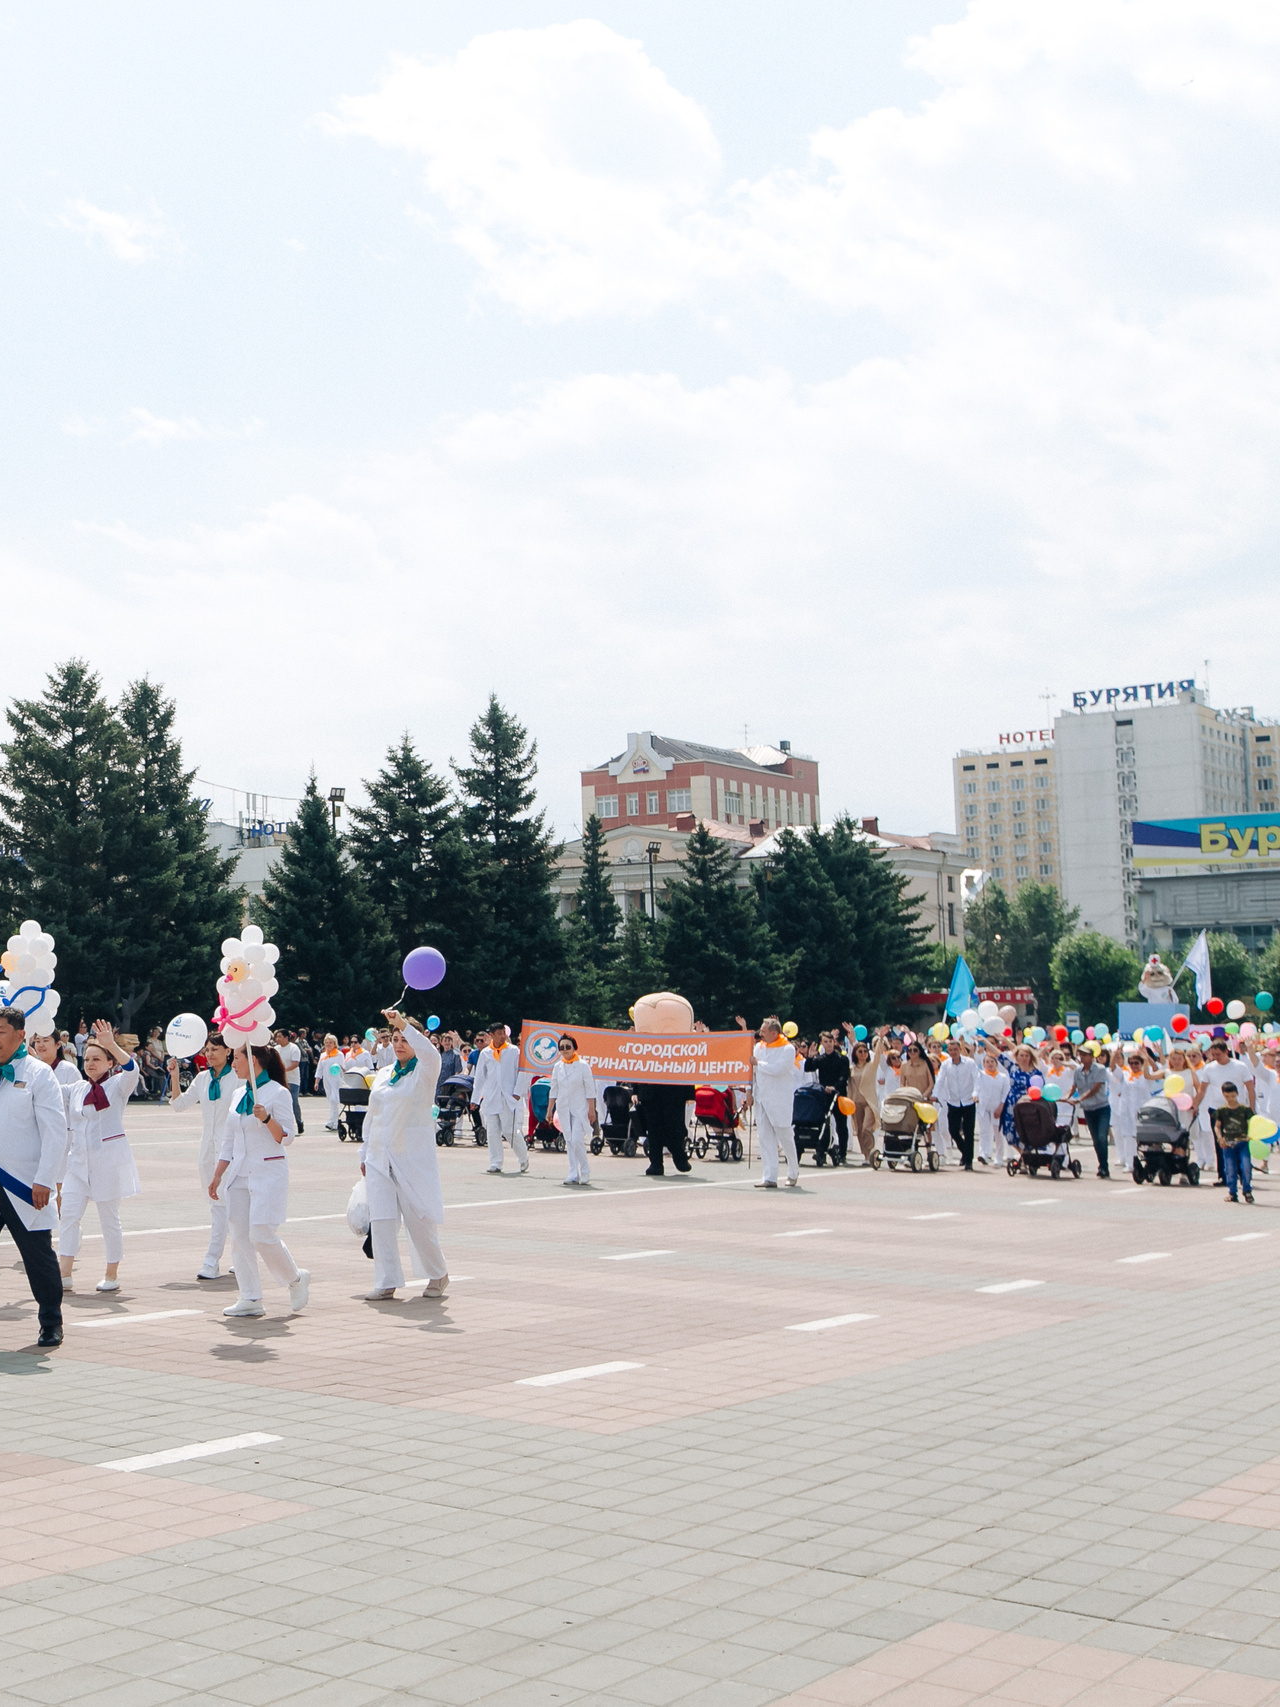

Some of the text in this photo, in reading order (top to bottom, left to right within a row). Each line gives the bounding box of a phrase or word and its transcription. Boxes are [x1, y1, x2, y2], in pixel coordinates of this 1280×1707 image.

[1072, 679, 1195, 708] БУРЯТИЯ
[618, 1041, 708, 1058] «ГОРОДСКОЙ
[698, 1061, 750, 1076] ЦЕНТР»
